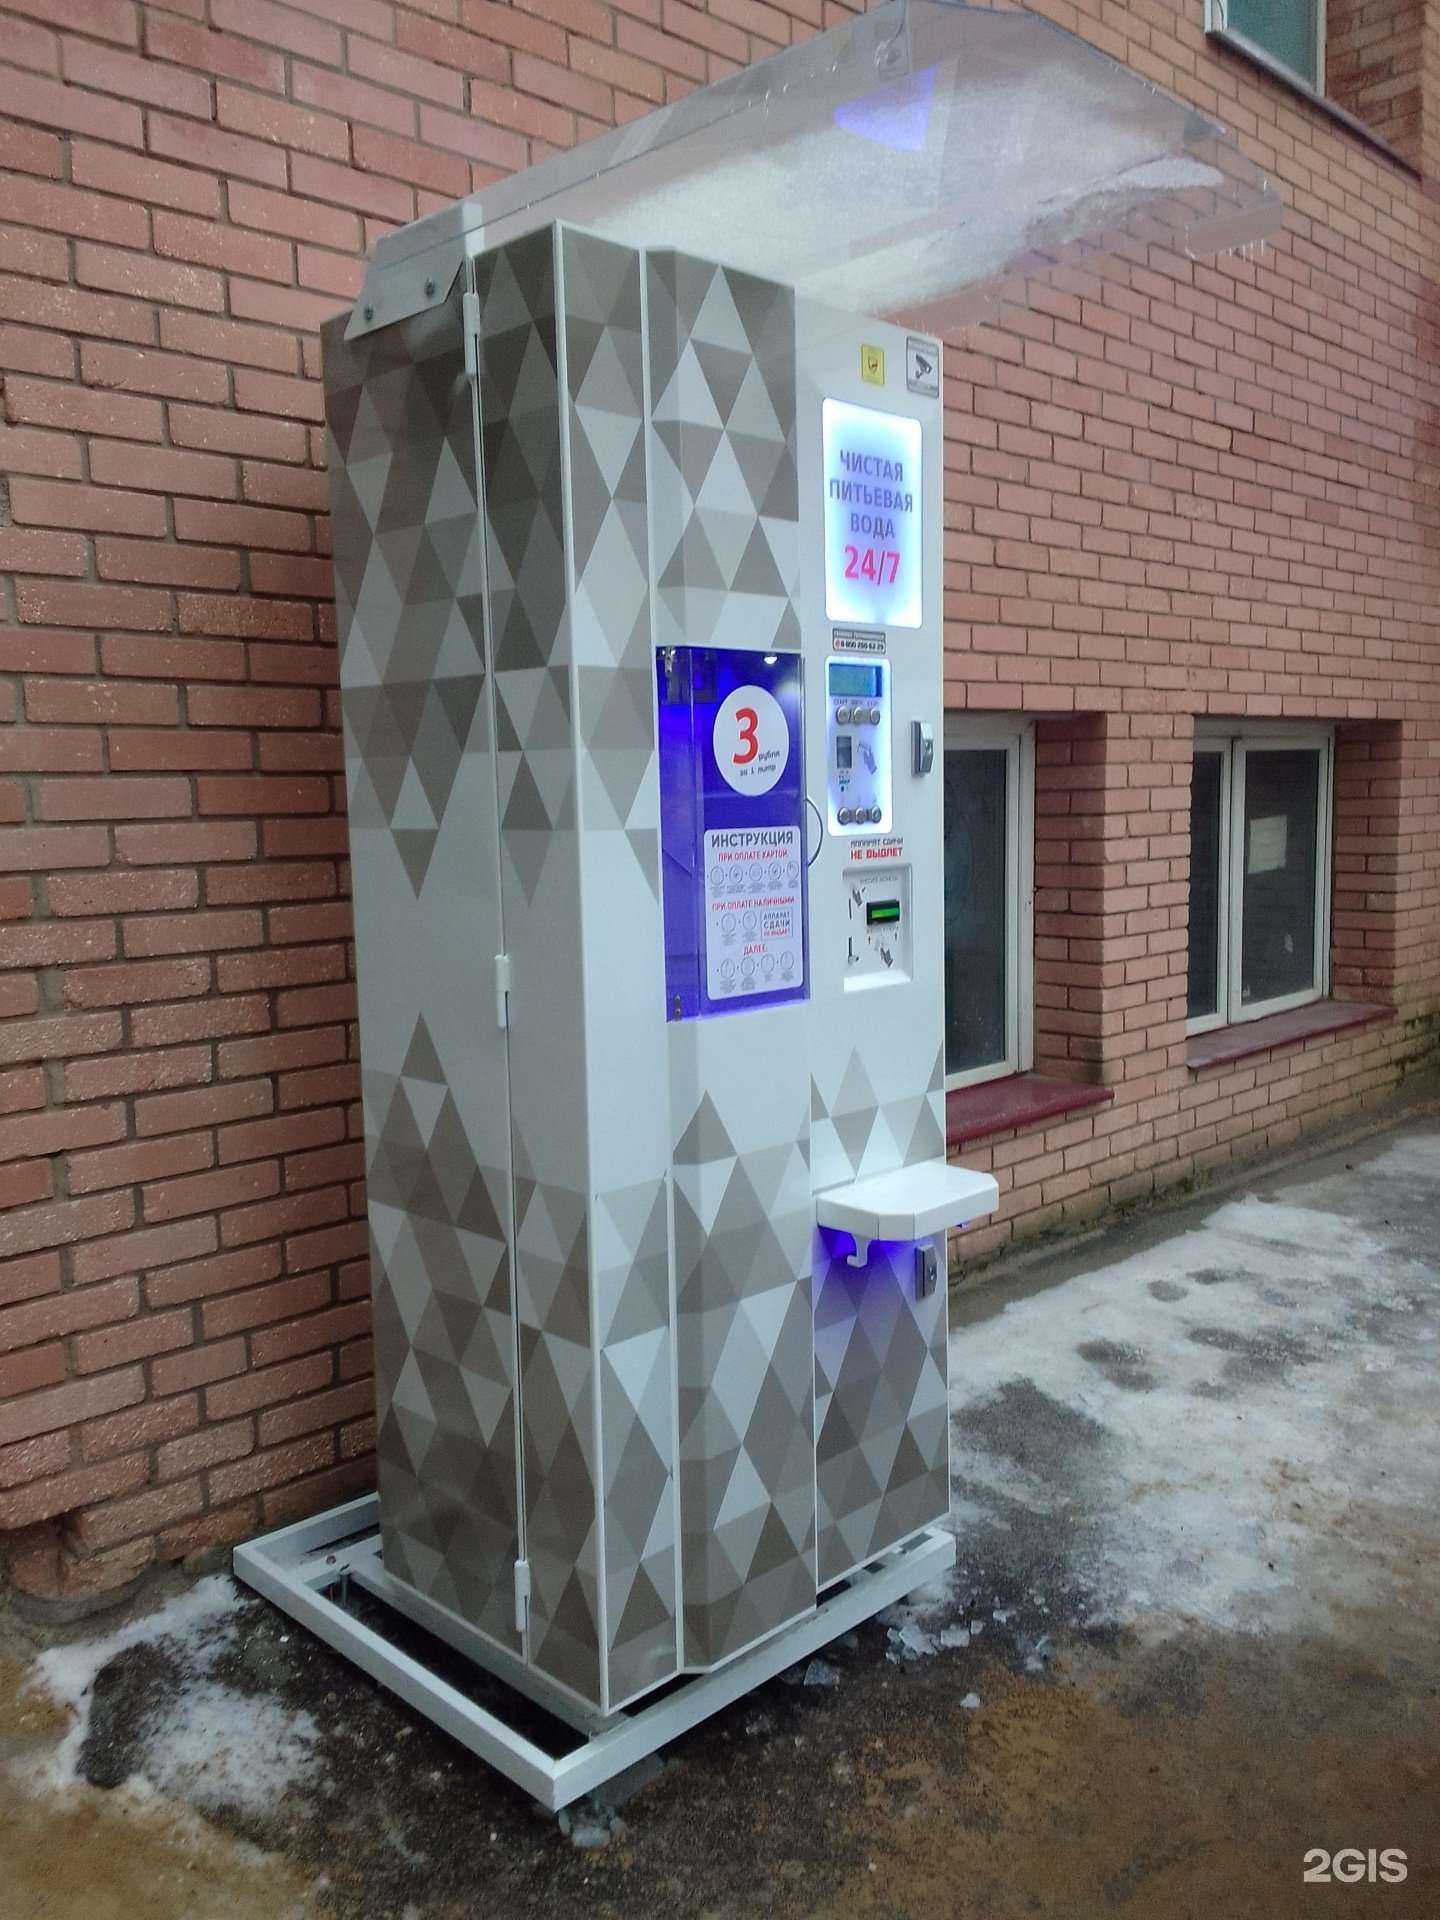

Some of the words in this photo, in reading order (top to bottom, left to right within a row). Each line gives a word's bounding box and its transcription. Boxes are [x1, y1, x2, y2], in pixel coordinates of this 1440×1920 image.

[840, 449, 904, 482] ЧИСТАЯ
[829, 478, 913, 513] ПИТЬЕВАЯ
[850, 512, 895, 540] ВОДА
[844, 544, 901, 585] 24/7
[733, 707, 759, 764] 3
[711, 831, 794, 848] ИНСТРУКЦИЯ
[718, 851, 733, 863] ПРИ
[735, 850, 760, 861] ОПЛАТЕ
[851, 849, 863, 860] НЕ
[763, 920, 791, 930] СДАЧИ
